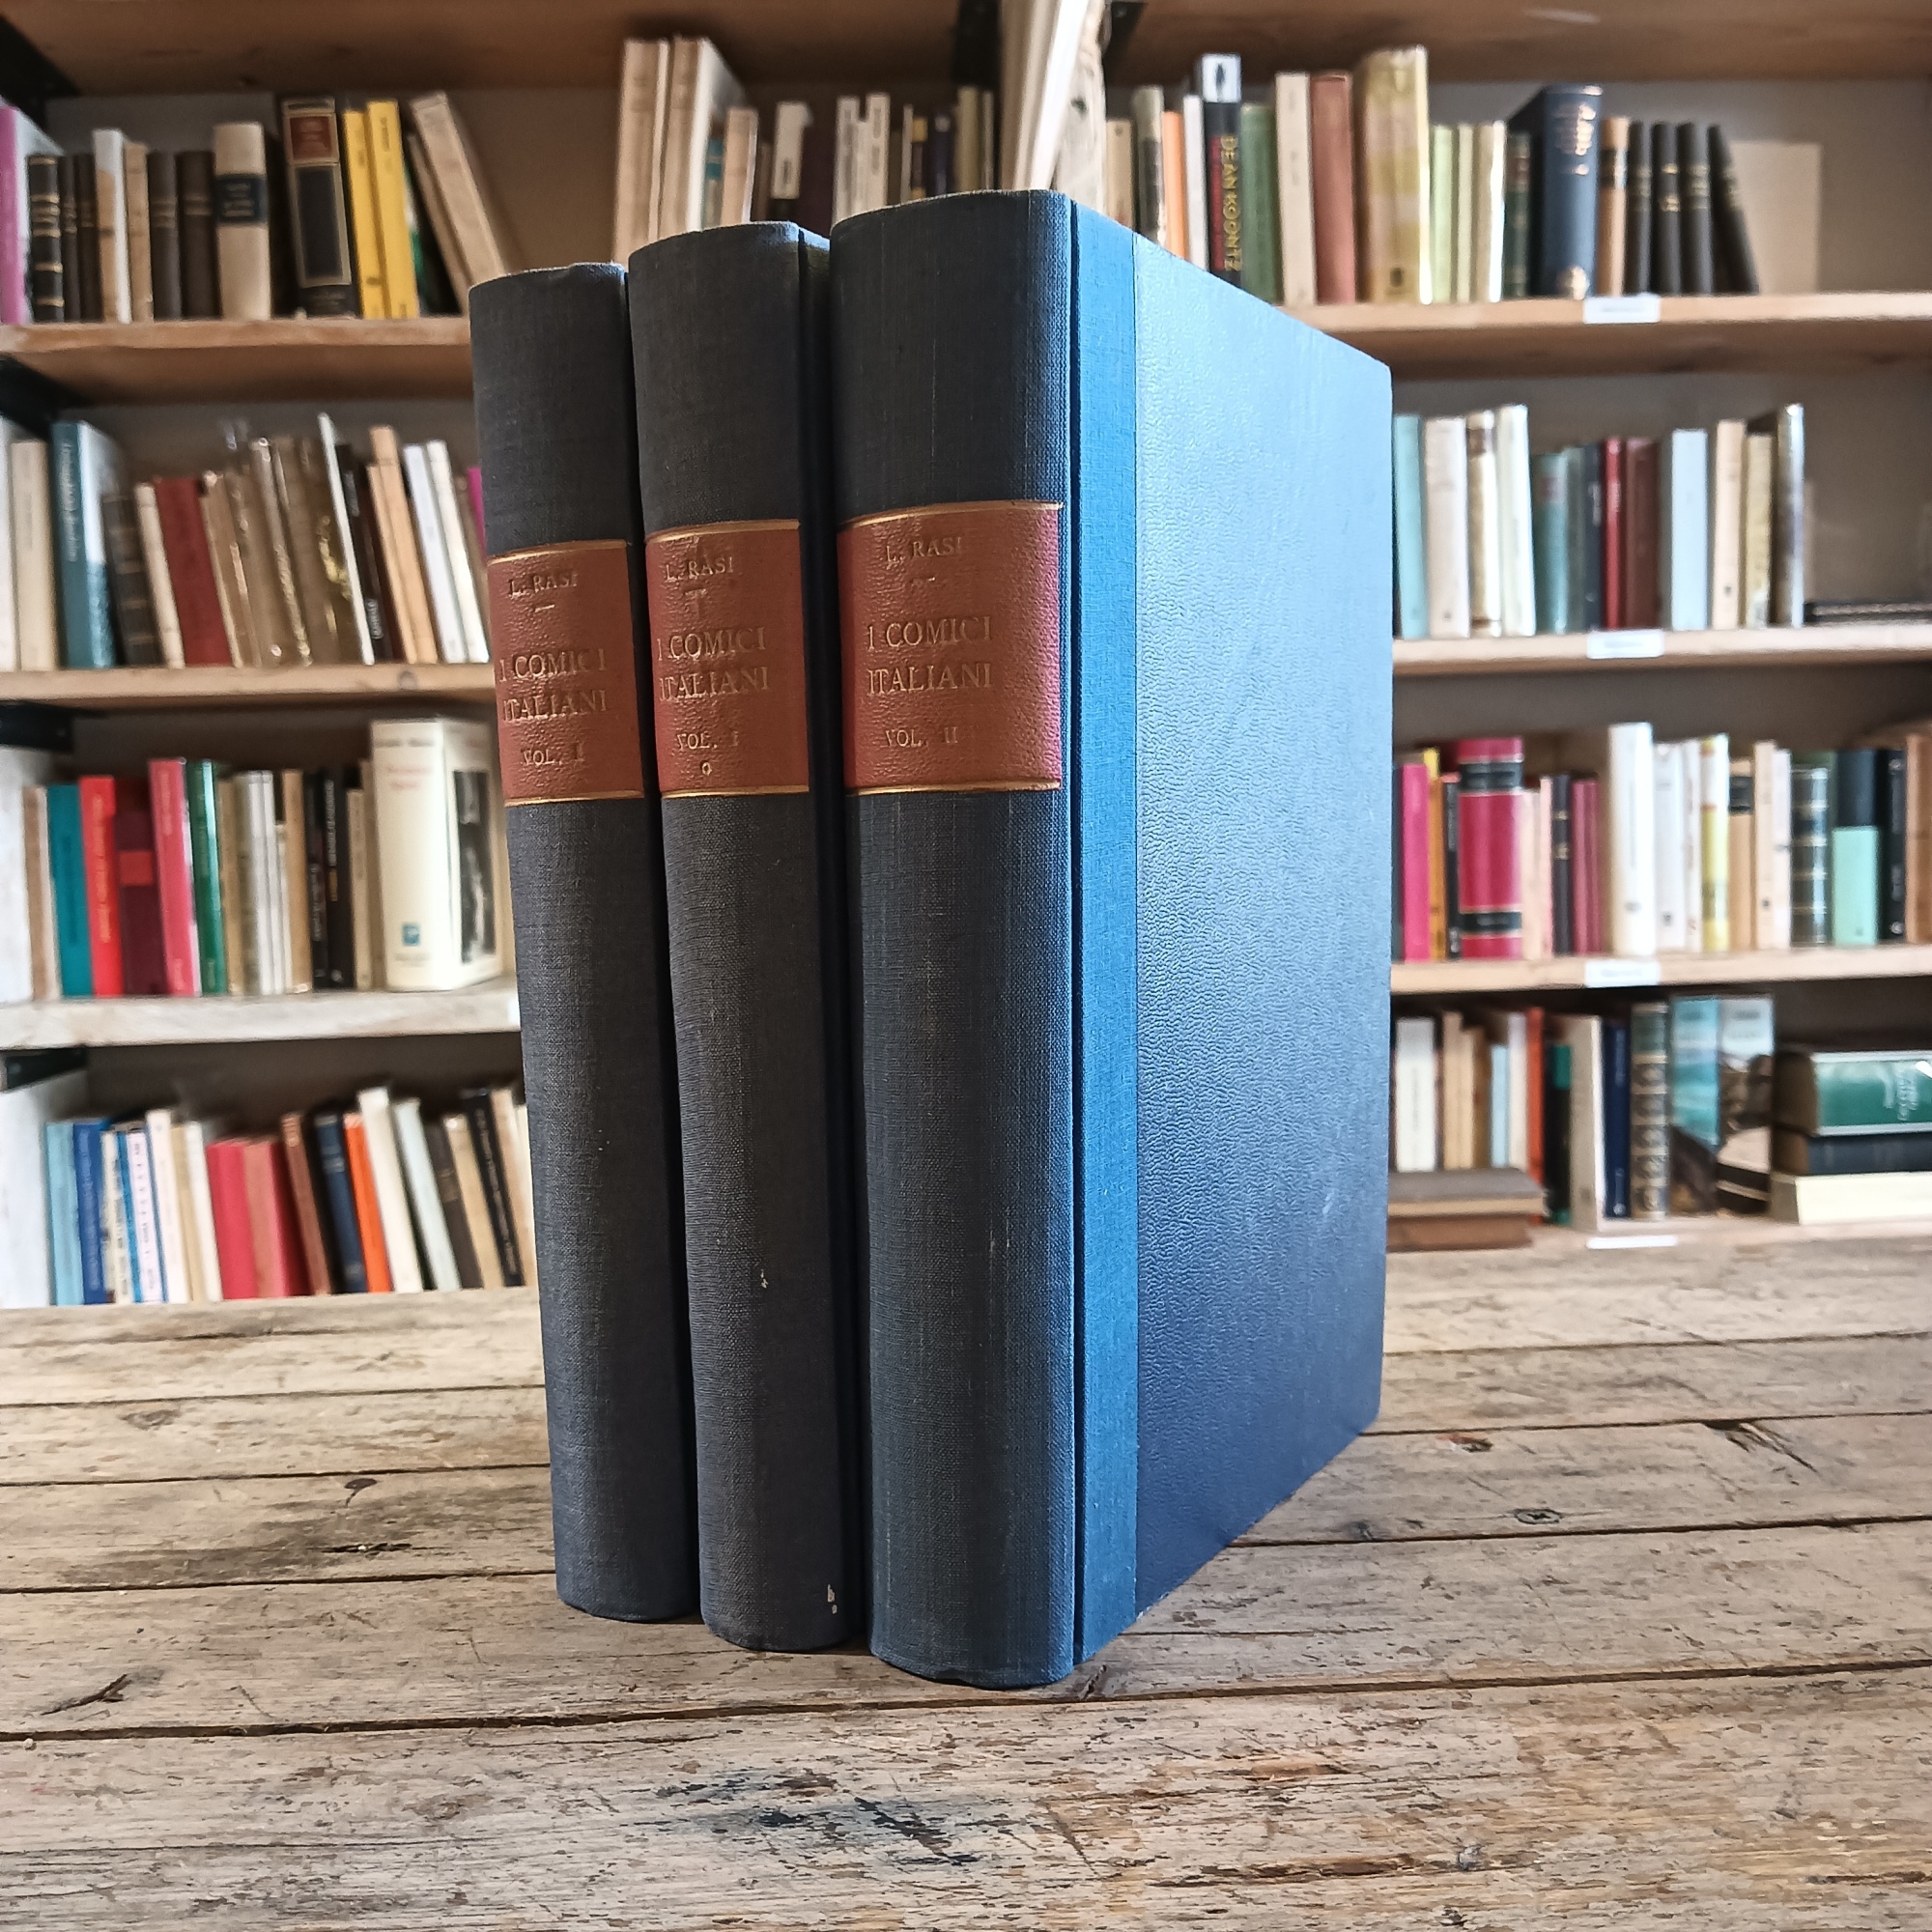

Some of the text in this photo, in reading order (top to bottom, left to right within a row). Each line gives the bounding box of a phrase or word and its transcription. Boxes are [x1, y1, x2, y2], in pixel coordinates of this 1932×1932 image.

[1220, 135, 1242, 271] DEAN KOONTZ
[688, 556, 734, 580] RASI
[886, 536, 962, 568] L. RASI
[532, 570, 578, 593] RASI
[657, 626, 766, 662] I COMICI
[867, 615, 993, 651] I COMICI
[498, 648, 606, 682] I COMICI
[867, 663, 992, 696] ITALIANI
[659, 666, 769, 702] ITALIANI
[503, 689, 607, 723] ITALIANI
[676, 732, 718, 751] VOL.
[885, 726, 959, 748] VOL. II
[522, 746, 562, 766] VOL.
